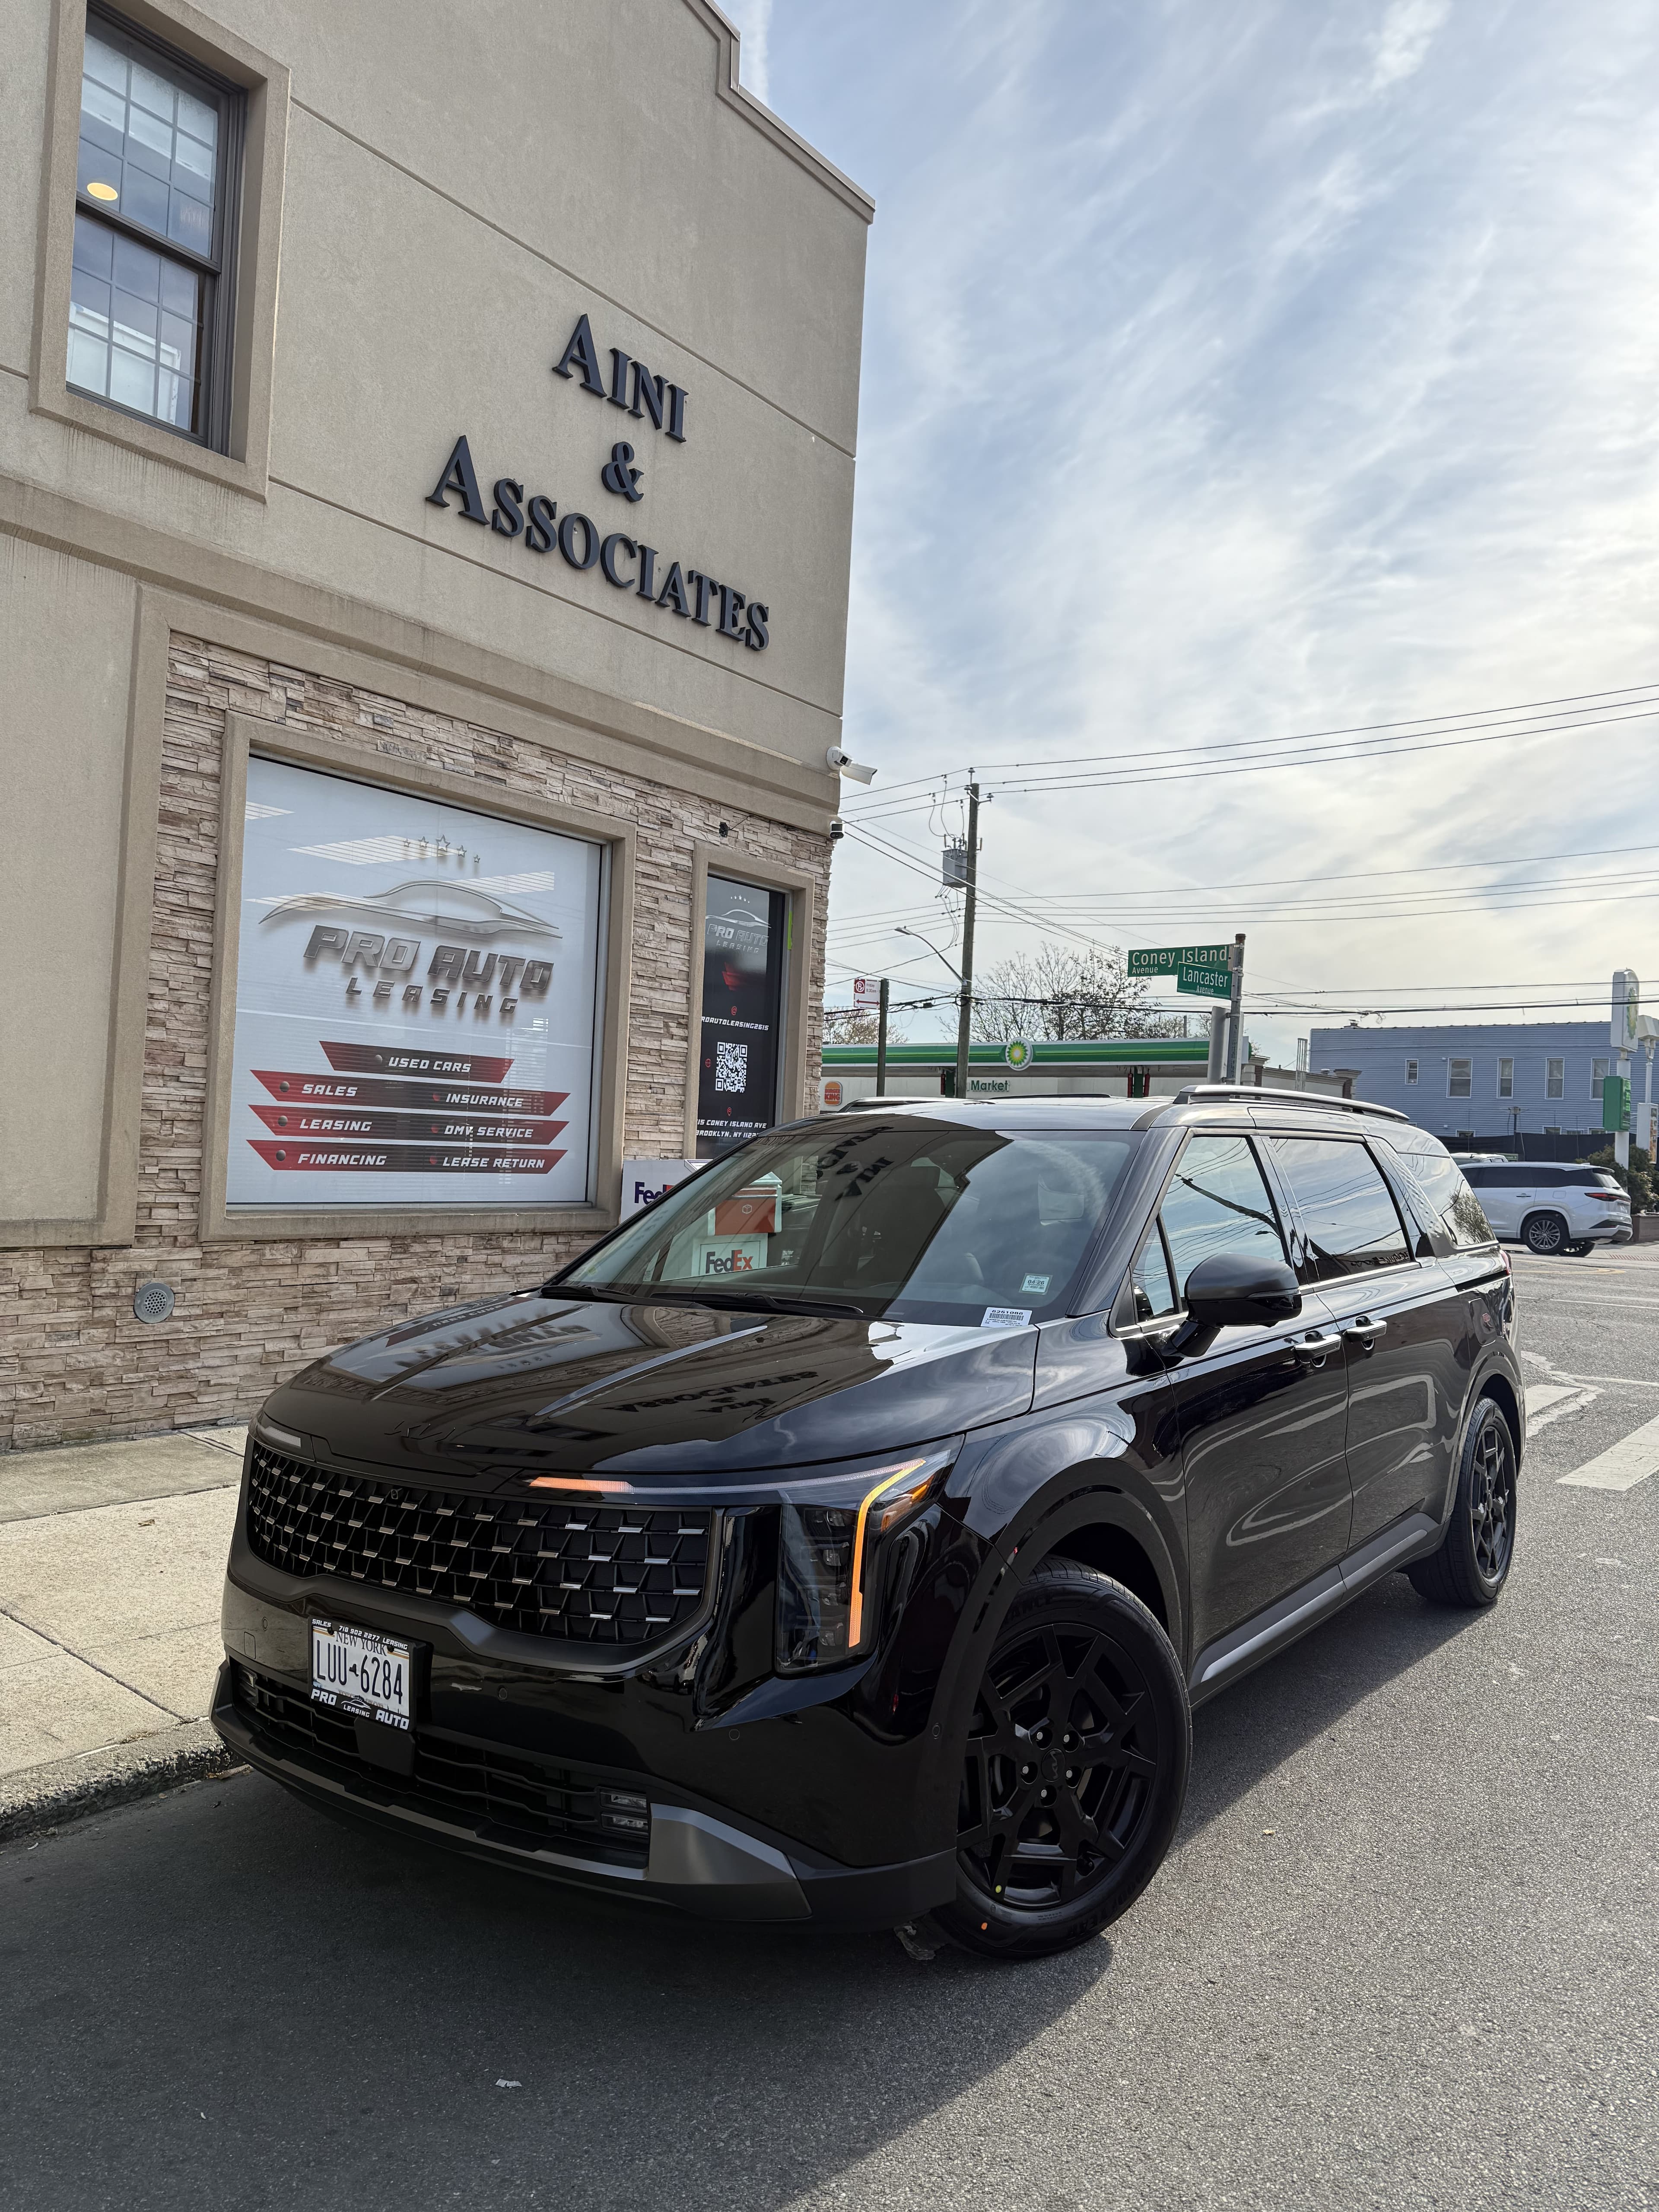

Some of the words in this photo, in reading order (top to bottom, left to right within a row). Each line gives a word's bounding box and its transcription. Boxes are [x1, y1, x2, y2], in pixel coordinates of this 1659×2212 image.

[552, 313, 689, 443] AINI
[601, 441, 645, 502] &
[426, 435, 769, 651] ASSOCIATES
[707, 924, 734, 939] PRO
[736, 930, 769, 947] AUTO
[716, 940, 760, 953] LEASING
[1132, 952, 1176, 967] Coney
[1182, 946, 1227, 963] Island
[303, 925, 421, 971] PRO
[427, 945, 554, 990] AUTO
[1183, 966, 1228, 987] Lancaster
[346, 977, 518, 1013] LEASING
[1196, 985, 1214, 995] Avenue
[702, 1016, 769, 1030] ROAUTOLEASING2615
[388, 1057, 429, 1069] USED
[433, 1061, 471, 1072] CARS
[302, 1084, 358, 1096] SALES
[971, 1080, 1008, 1091] Market
[446, 1093, 524, 1107] INSURANCE
[300, 1119, 372, 1131] LEASING
[444, 1125, 473, 1135] DMV
[477, 1127, 534, 1138] SERVICE
[298, 1154, 387, 1165] FINANCING
[442, 1157, 489, 1167] LEASE
[493, 1158, 545, 1168] RETURN
[634, 1181, 675, 1205] Fed
[706, 1249, 753, 1274] FedEx
[312, 1619, 331, 1627] SALES
[350, 1628, 362, 1637] 902
[363, 1632, 380, 1641] 2277
[382, 1637, 408, 1650] LEASING
[336, 1632, 357, 1647] NEW
[361, 1638, 387, 1656] YORK
[317, 1640, 347, 1686] LUU
[360, 1654, 403, 1705] 6284
[311, 1688, 337, 1706] PRO
[343, 1704, 370, 1718] LEASING
[375, 1709, 410, 1730] AUTO
